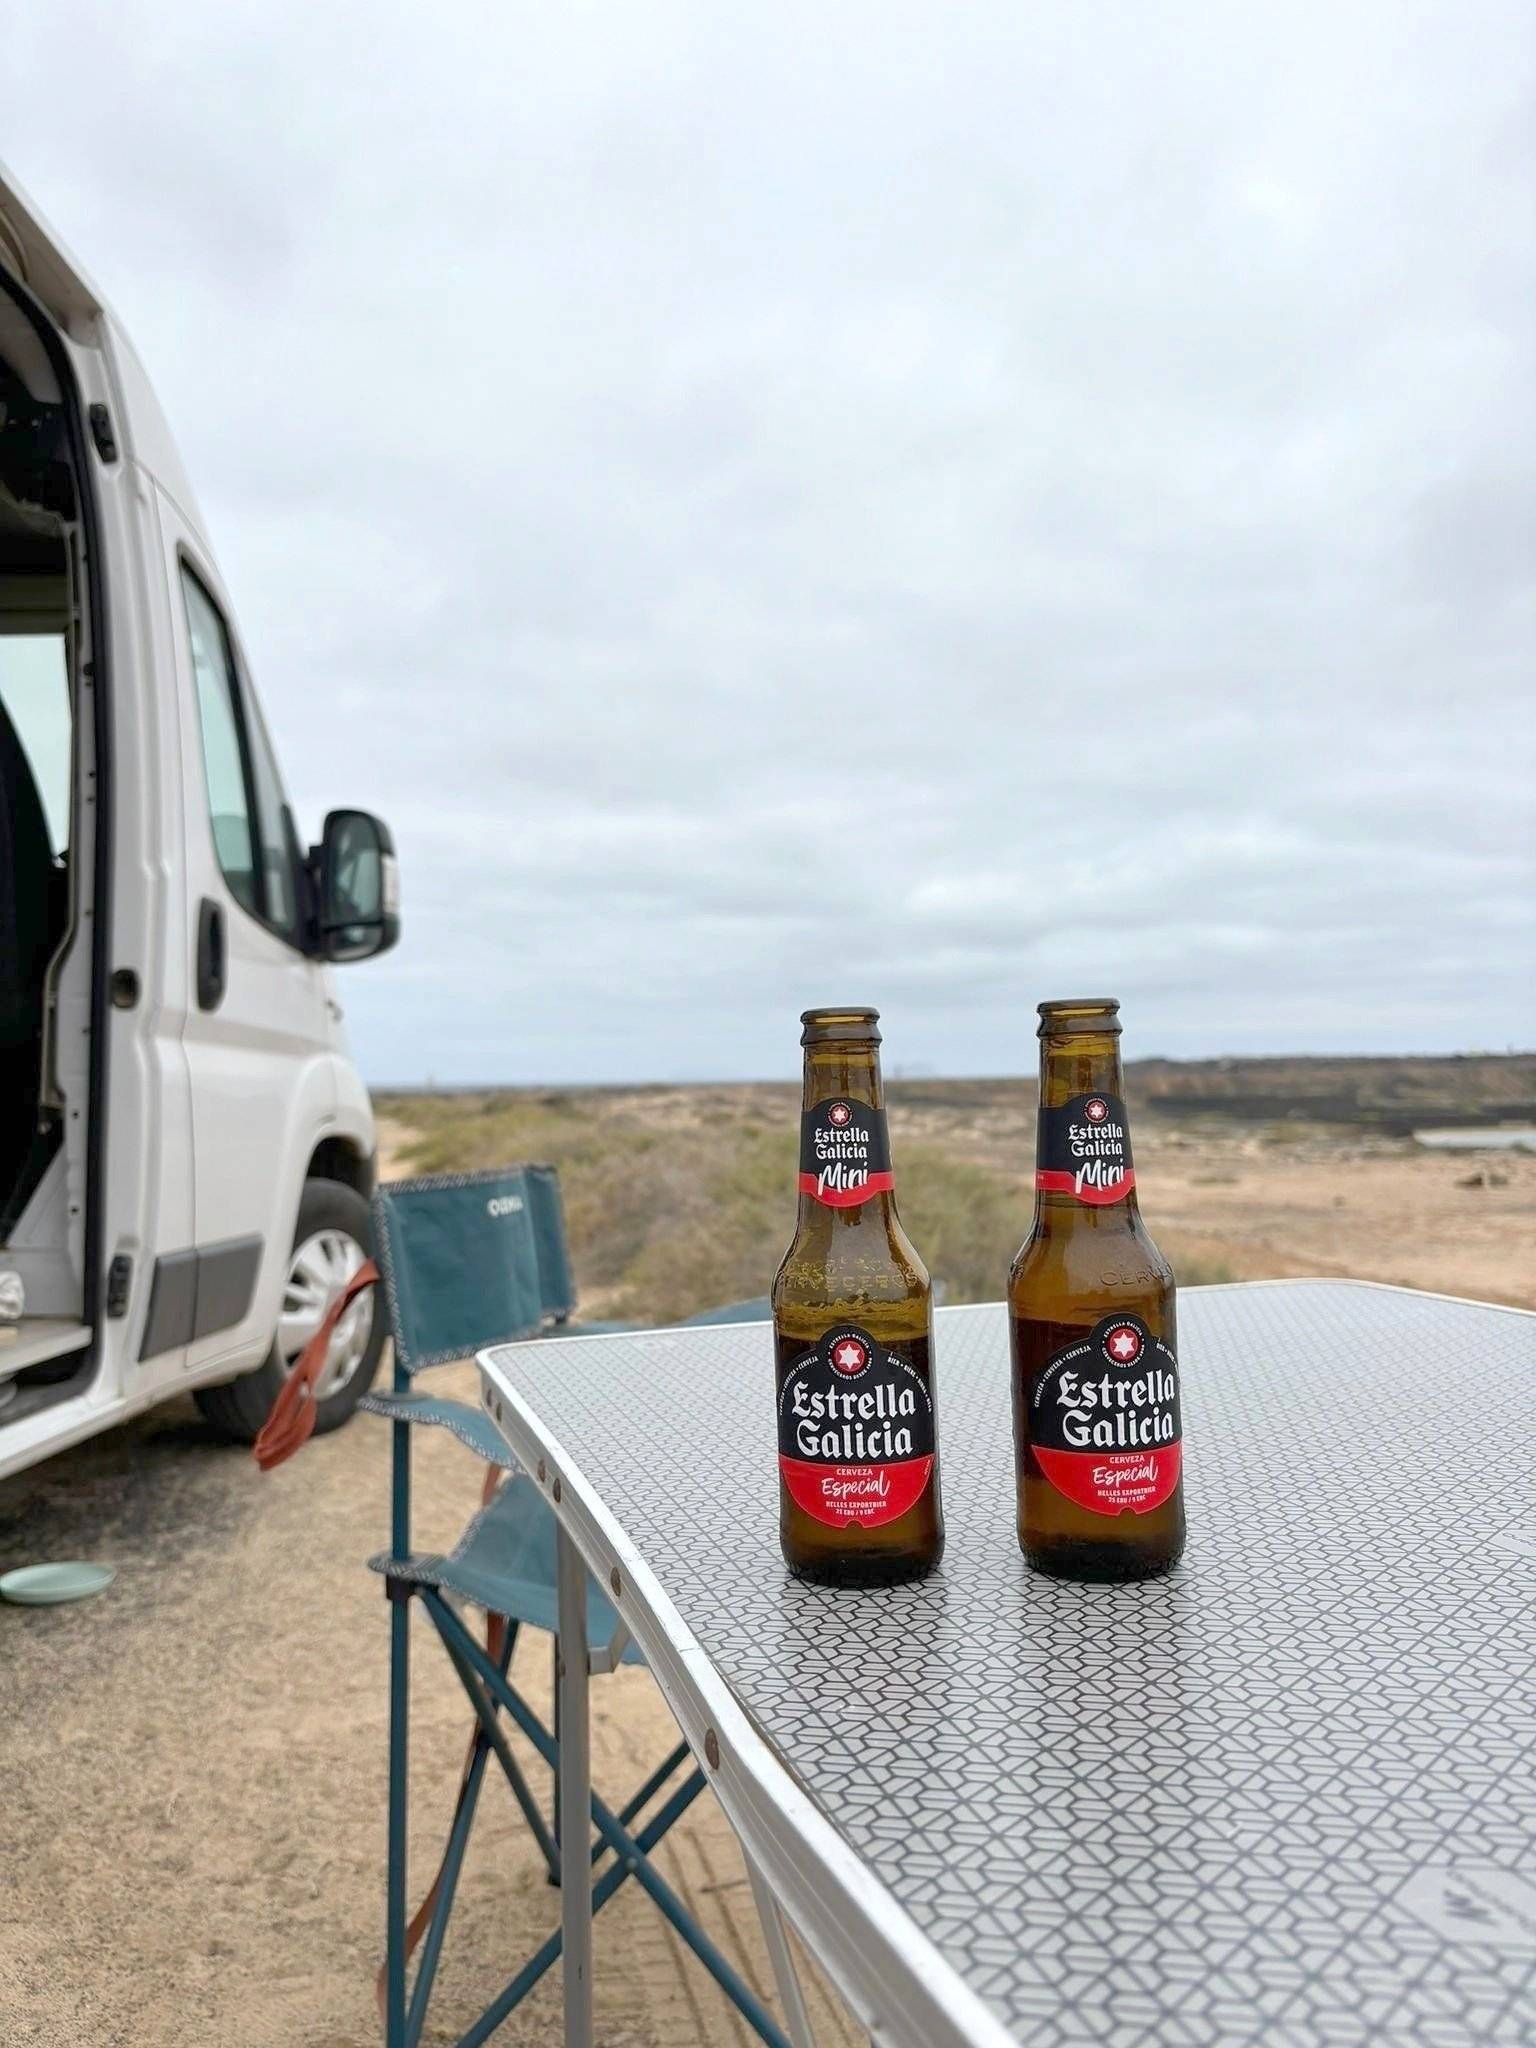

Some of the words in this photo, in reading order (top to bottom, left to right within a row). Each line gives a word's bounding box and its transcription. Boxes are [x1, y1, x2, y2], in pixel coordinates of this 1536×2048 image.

[814, 1127, 869, 1143] Estrella
[1068, 1123, 1123, 1140] Estrella
[816, 1142, 868, 1159] Galicia
[1071, 1139, 1123, 1157] Galicia
[817, 1161, 868, 1196] Mini
[1075, 1158, 1124, 1194] Mini
[791, 1381, 916, 1420] Estrella
[1056, 1369, 1175, 1409] Estrella
[796, 1418, 915, 1459] Galicia
[1062, 1407, 1175, 1447] Galicia
[836, 1468, 873, 1476] CERVEZA
[1092, 1456, 1159, 1488] Especial
[1109, 1455, 1145, 1464] CERVEZA
[821, 1470, 891, 1500] Especial
